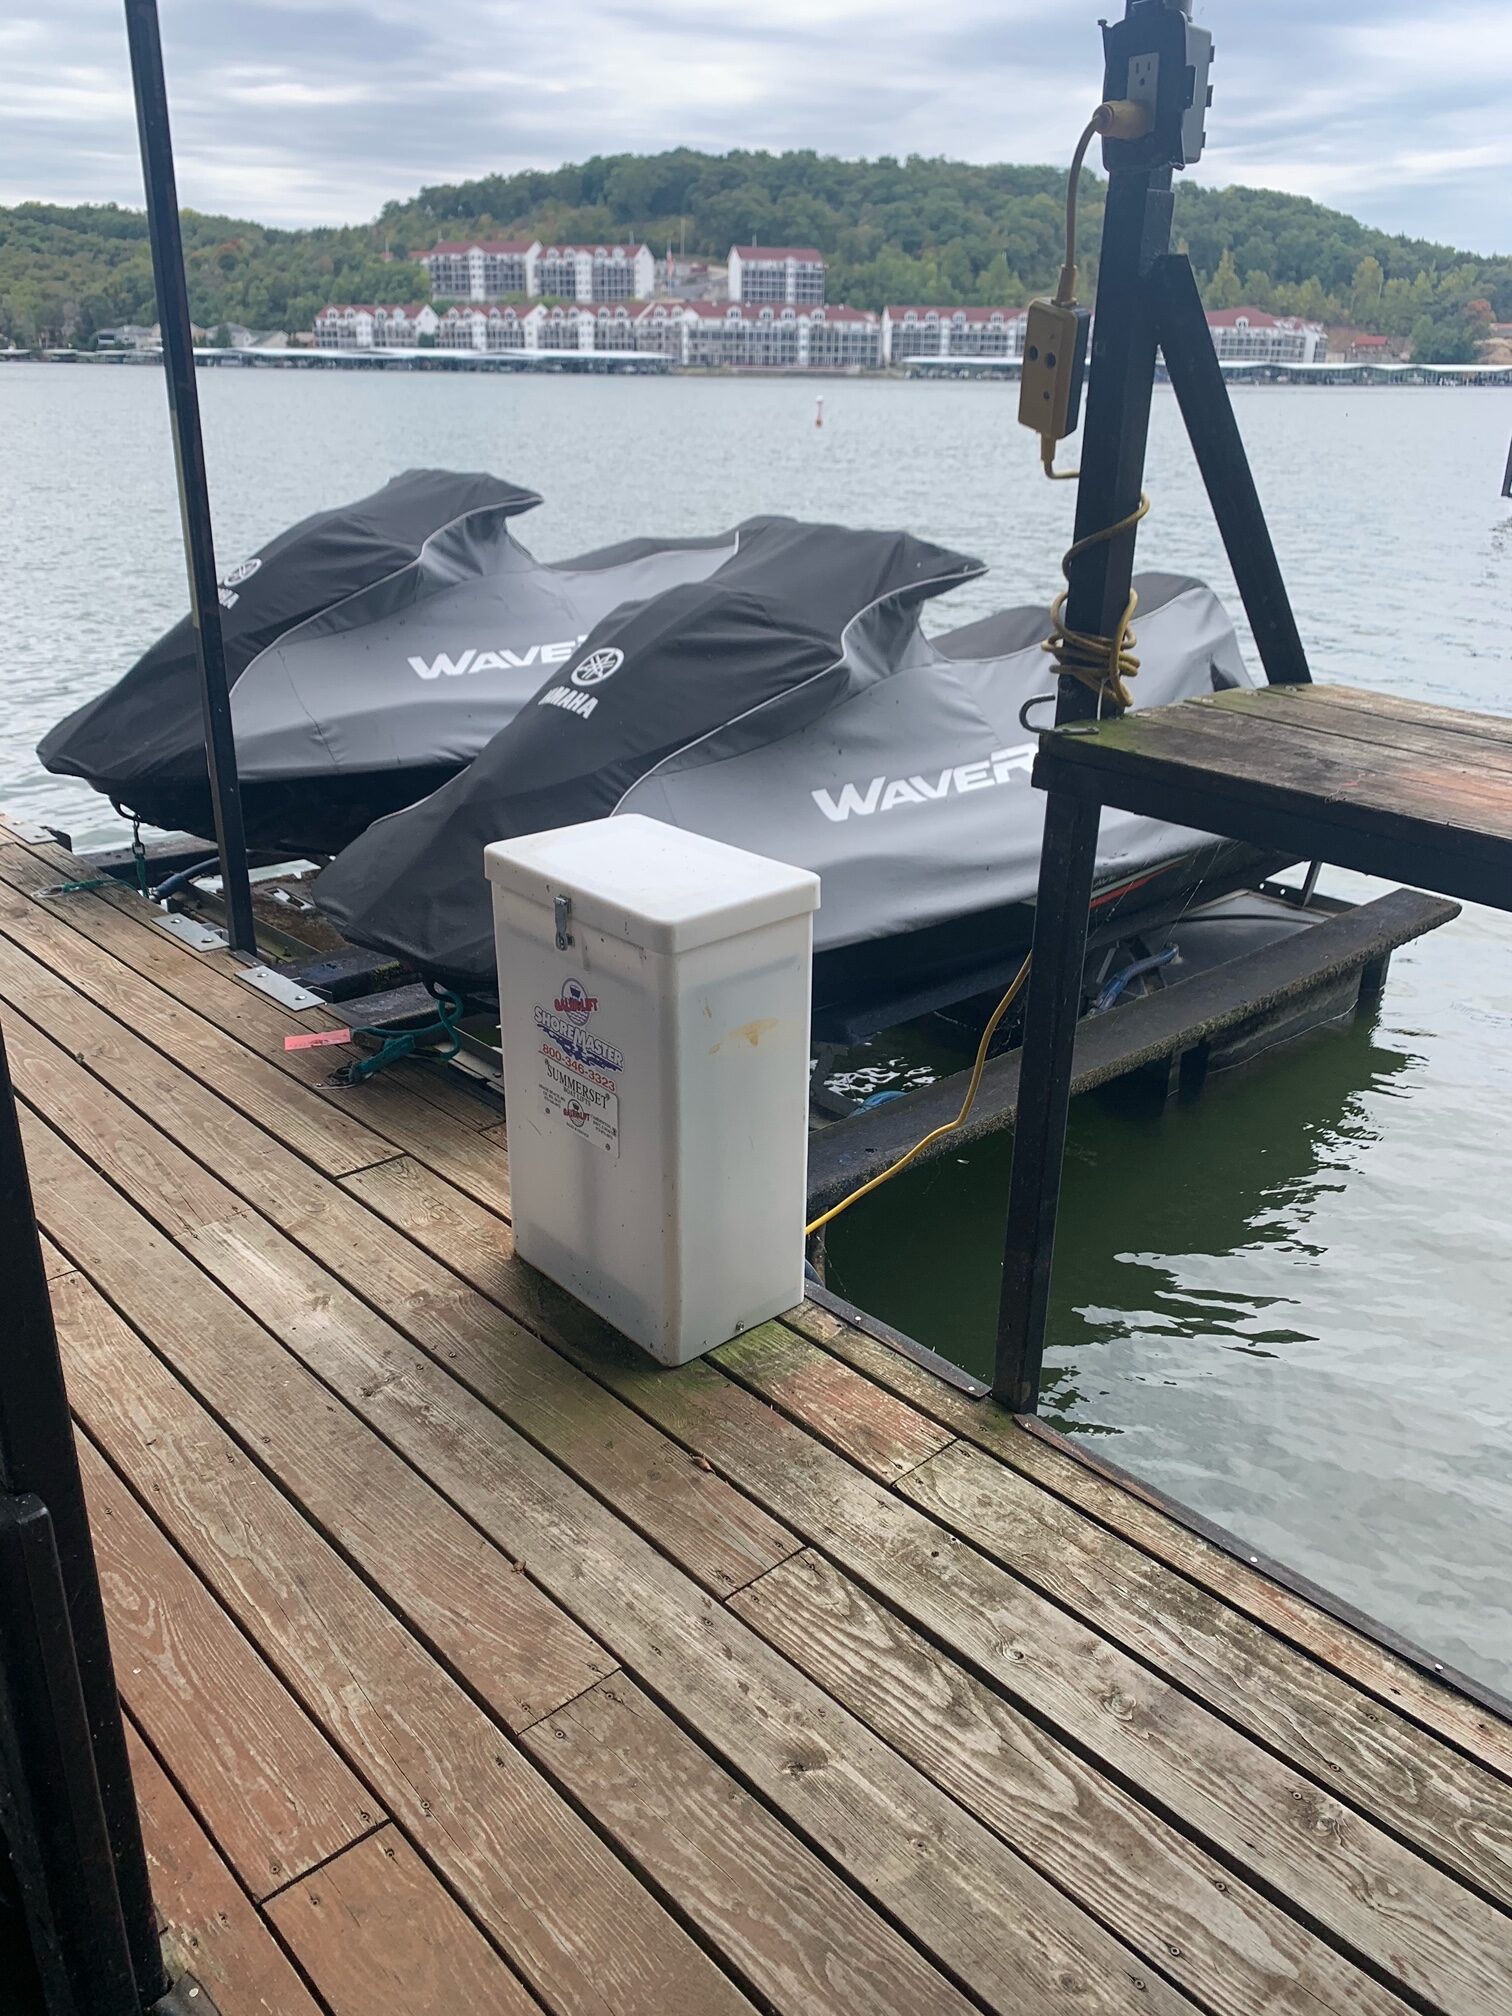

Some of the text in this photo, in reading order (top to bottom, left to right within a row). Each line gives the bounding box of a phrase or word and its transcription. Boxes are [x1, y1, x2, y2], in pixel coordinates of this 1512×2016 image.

[534, 1005, 624, 1068] SHOREMASTER
[542, 1043, 615, 1092] 800-346-3323
[547, 1064, 606, 1110] SUMMERSET
